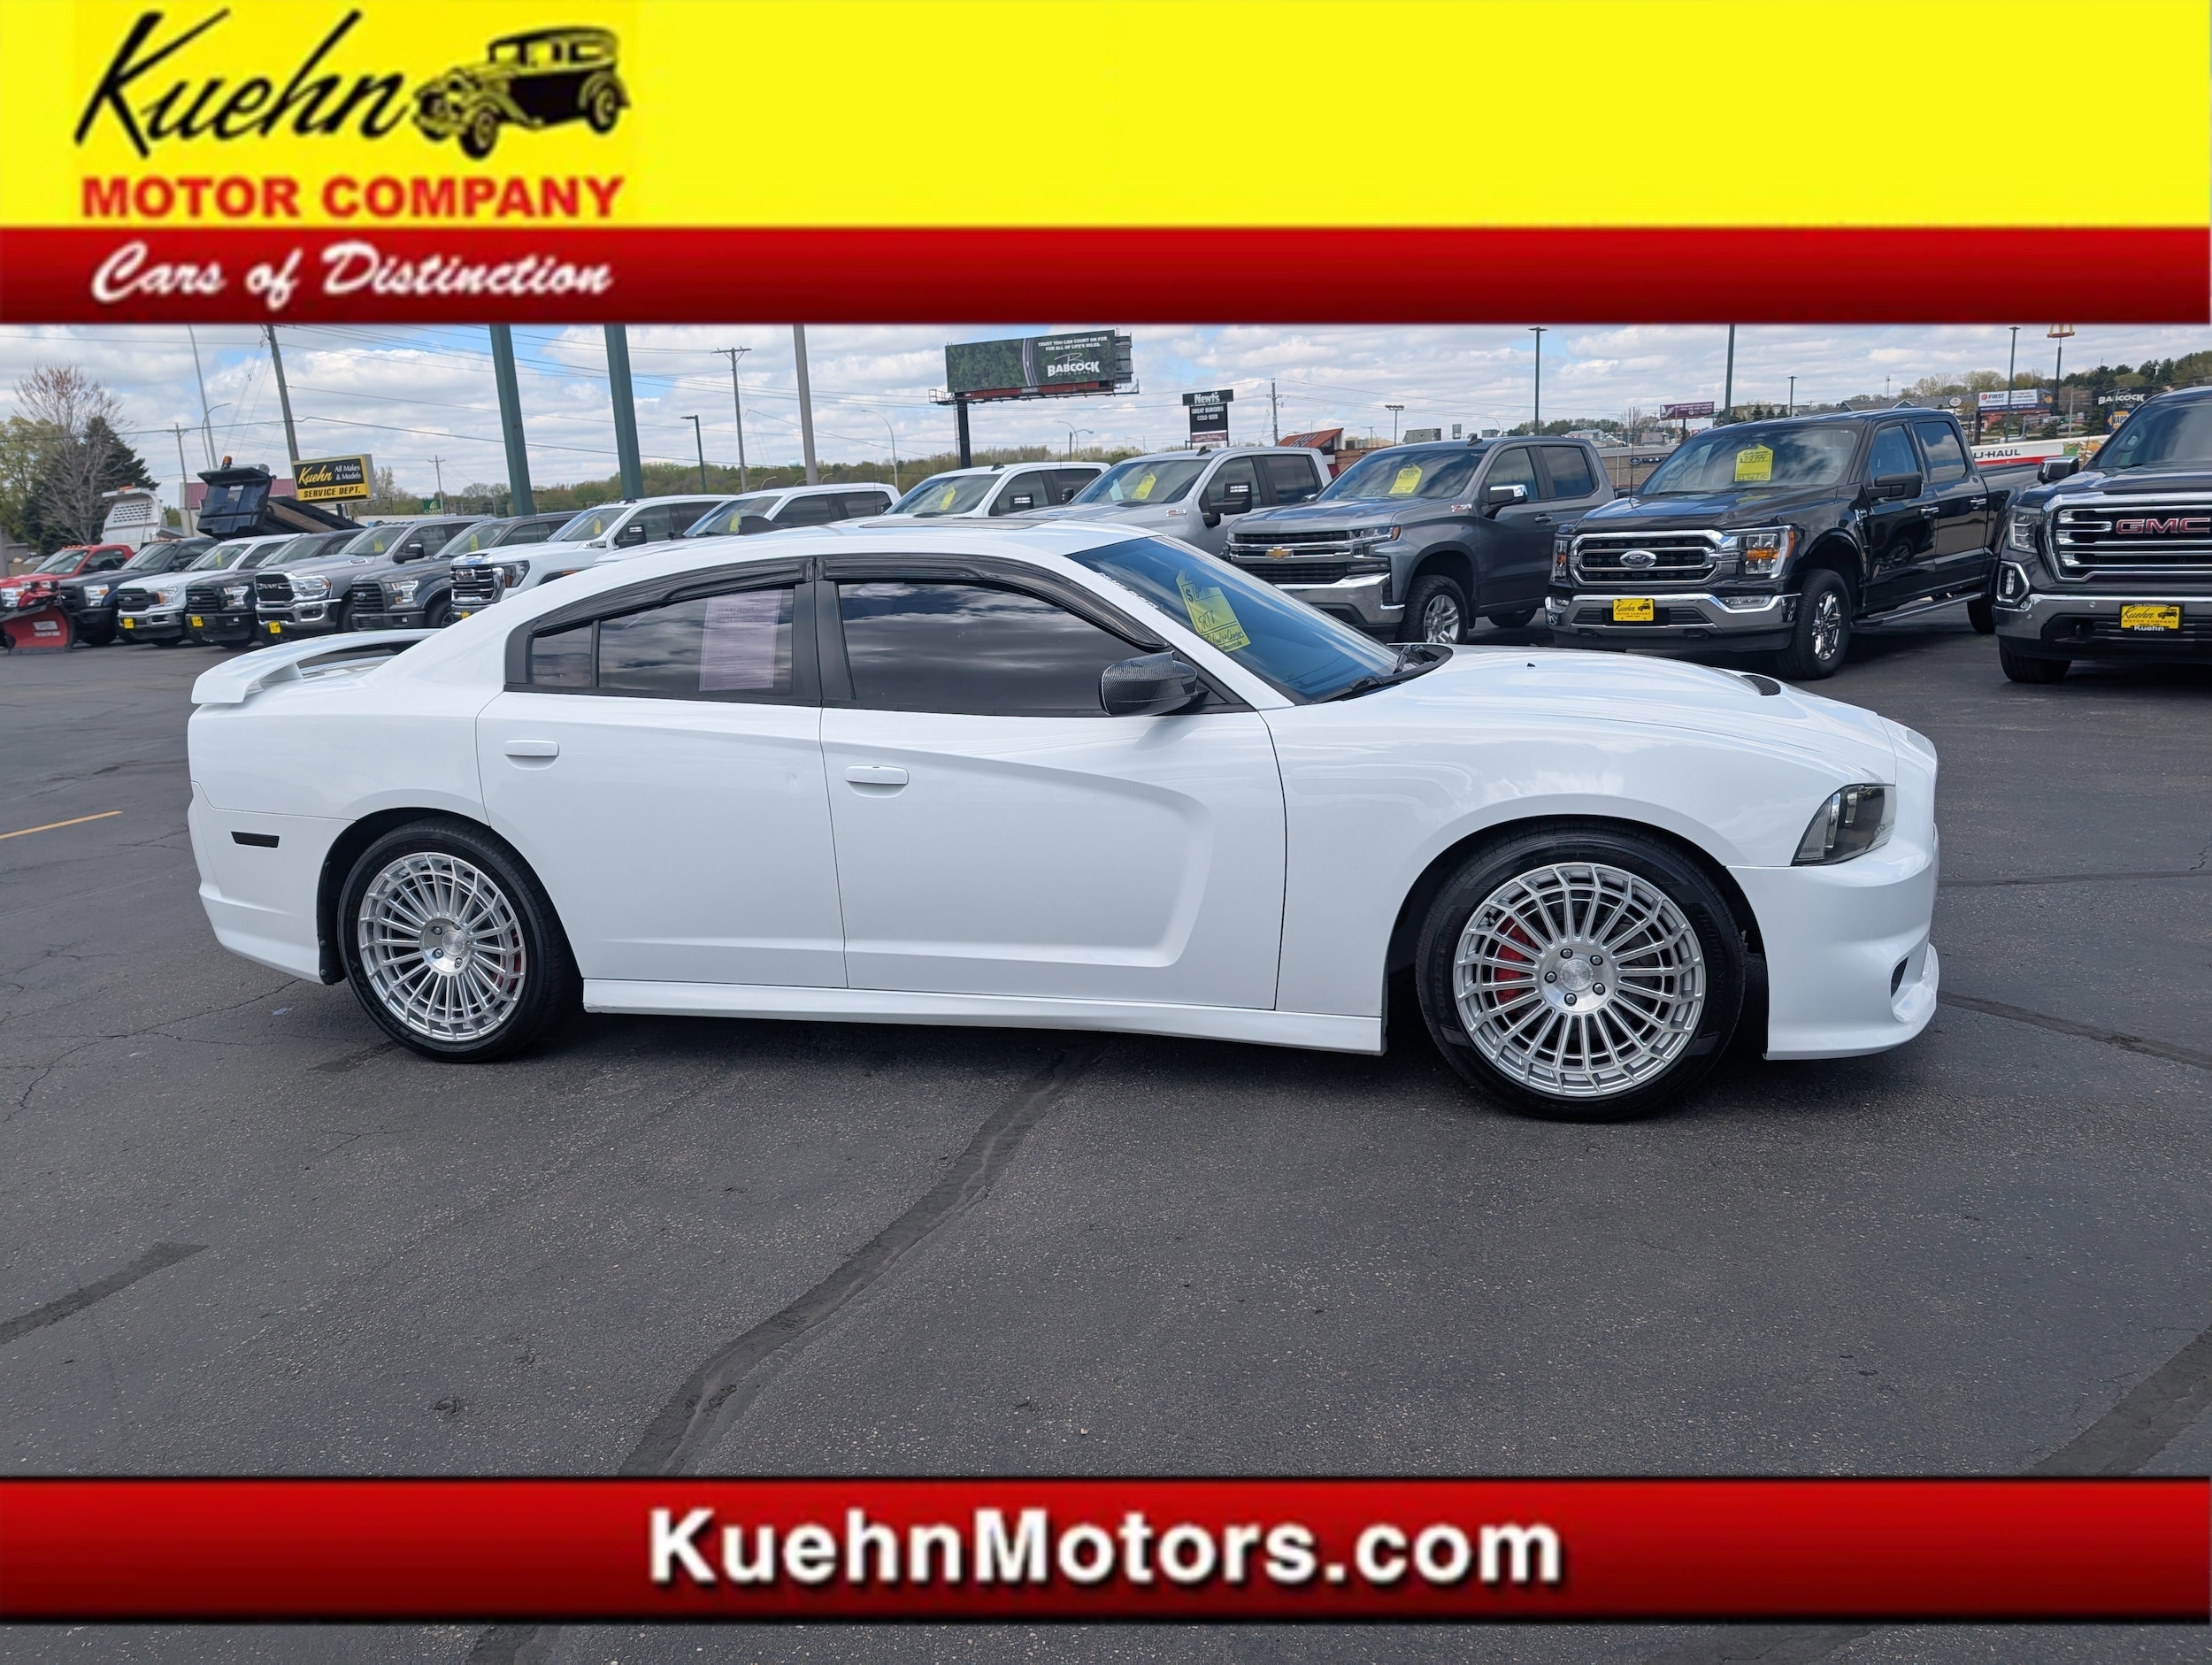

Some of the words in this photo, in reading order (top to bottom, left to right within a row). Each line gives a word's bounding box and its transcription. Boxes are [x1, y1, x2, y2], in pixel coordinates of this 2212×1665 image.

[1047, 361, 1101, 378] BABCOCK
[1194, 391, 1220, 404] Newt's
[1973, 449, 2021, 459] U-HAUL
[298, 464, 333, 486] Kuehn
[303, 487, 337, 498] SERVICE
[339, 486, 361, 496] DEPT.
[2116, 517, 2211, 534] GMC
[2122, 607, 2154, 619] Kuehn
